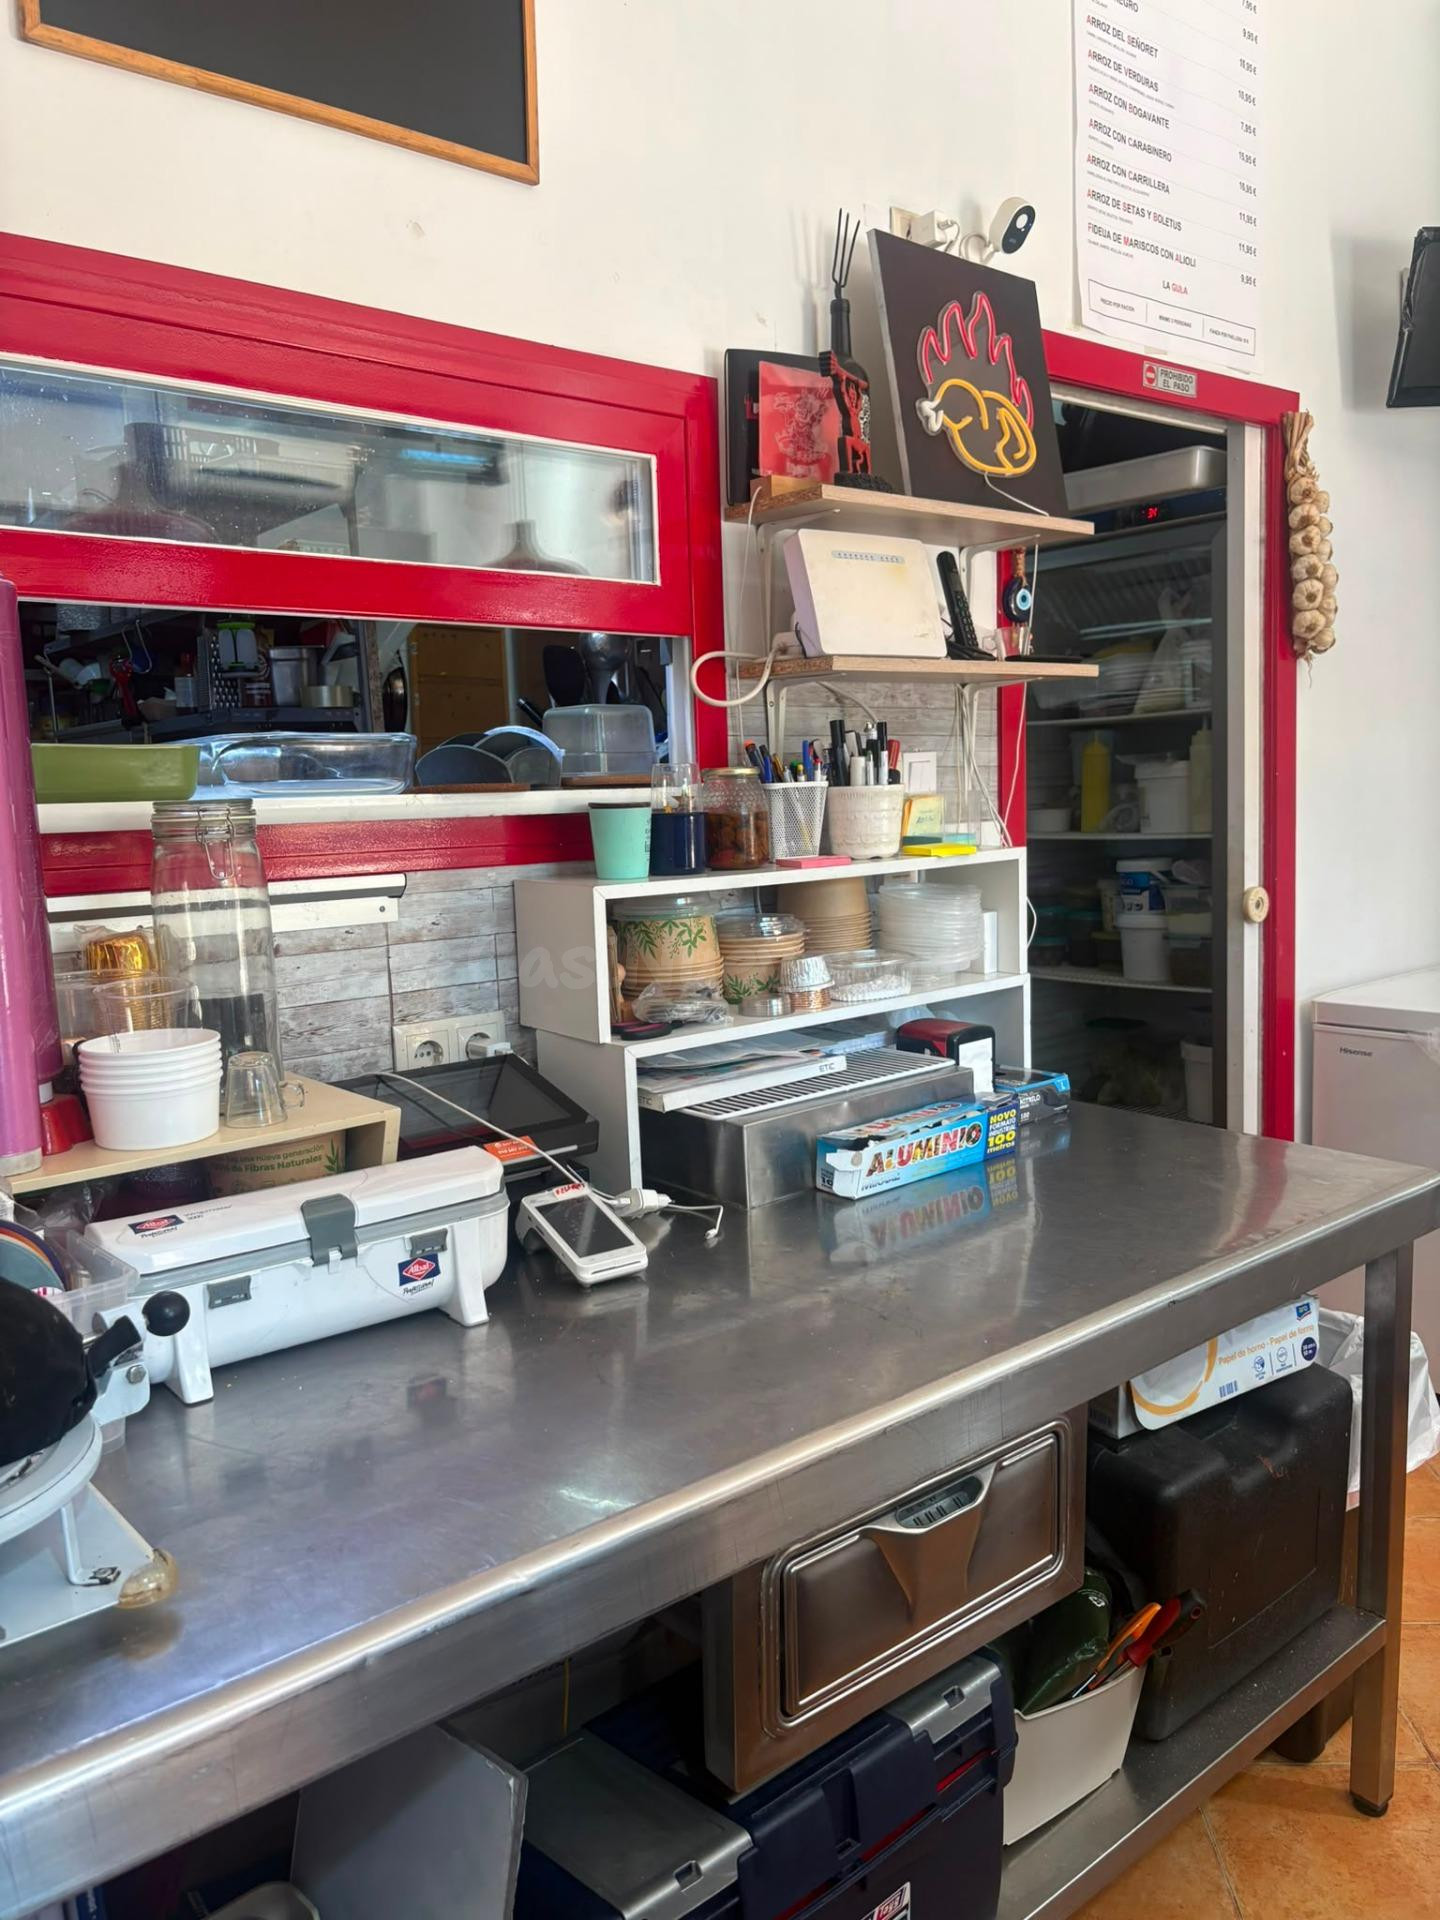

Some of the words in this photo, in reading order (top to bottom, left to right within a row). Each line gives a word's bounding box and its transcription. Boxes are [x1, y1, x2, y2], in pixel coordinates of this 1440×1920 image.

[1086, 15, 1110, 35] ARROZ
[1112, 27, 1125, 42] DEL
[1127, 35, 1158, 58] SEÑORET
[1088, 49, 1112, 69] ARROZ
[1113, 60, 1122, 74] DE
[1124, 66, 1159, 92] VERDURAS
[1088, 84, 1112, 103] ARROZ
[1114, 96, 1127, 110] CON
[1128, 103, 1170, 129] BOGAVANTE
[1088, 118, 1112, 138] ARROZ
[1112, 130, 1126, 145] CON
[1128, 137, 1172, 162] CARABINERO
[1087, 154, 1111, 172] ARROZ
[1112, 164, 1127, 178] CON
[1128, 171, 1170, 194] CARRILLERA
[1087, 189, 1111, 207] ARROZ
[1112, 198, 1121, 210] DE
[1122, 202, 1146, 219] SETAS
[1147, 210, 1152, 220] Y
[1152, 212, 1182, 232] BOLETUS
[1112, 232, 1122, 245] DE
[1123, 236, 1160, 255] MARISCOS
[1160, 247, 1174, 261] CON
[1175, 254, 1196, 267] ALIOLI
[1162, 280, 1170, 291] LA
[1172, 282, 1188, 295] GULA
[1160, 368, 1194, 384] PROHIBIDO
[1162, 379, 1171, 388] EL
[1173, 382, 1190, 392] PASO
[989, 1118, 1016, 1131] FORMATO
[990, 1109, 1017, 1124] NOVO
[988, 1130, 1015, 1147] 100
[989, 1124, 1016, 1136] INDUSTRIAL
[256, 1153, 281, 1162] nueva
[282, 1144, 324, 1160] generación
[866, 1122, 983, 1177] ALUMINIO
[987, 1142, 1015, 1154] metros
[244, 1162, 275, 1172] Fibras
[277, 1154, 322, 1170] Naturales
[821, 1177, 833, 1186] 10
[1218, 1354, 1236, 1365] Papel
[1247, 1342, 1265, 1354] horno
[1269, 1334, 1288, 1345] Papel
[1289, 1330, 1297, 1338] de
[1298, 1325, 1314, 1336] forno
